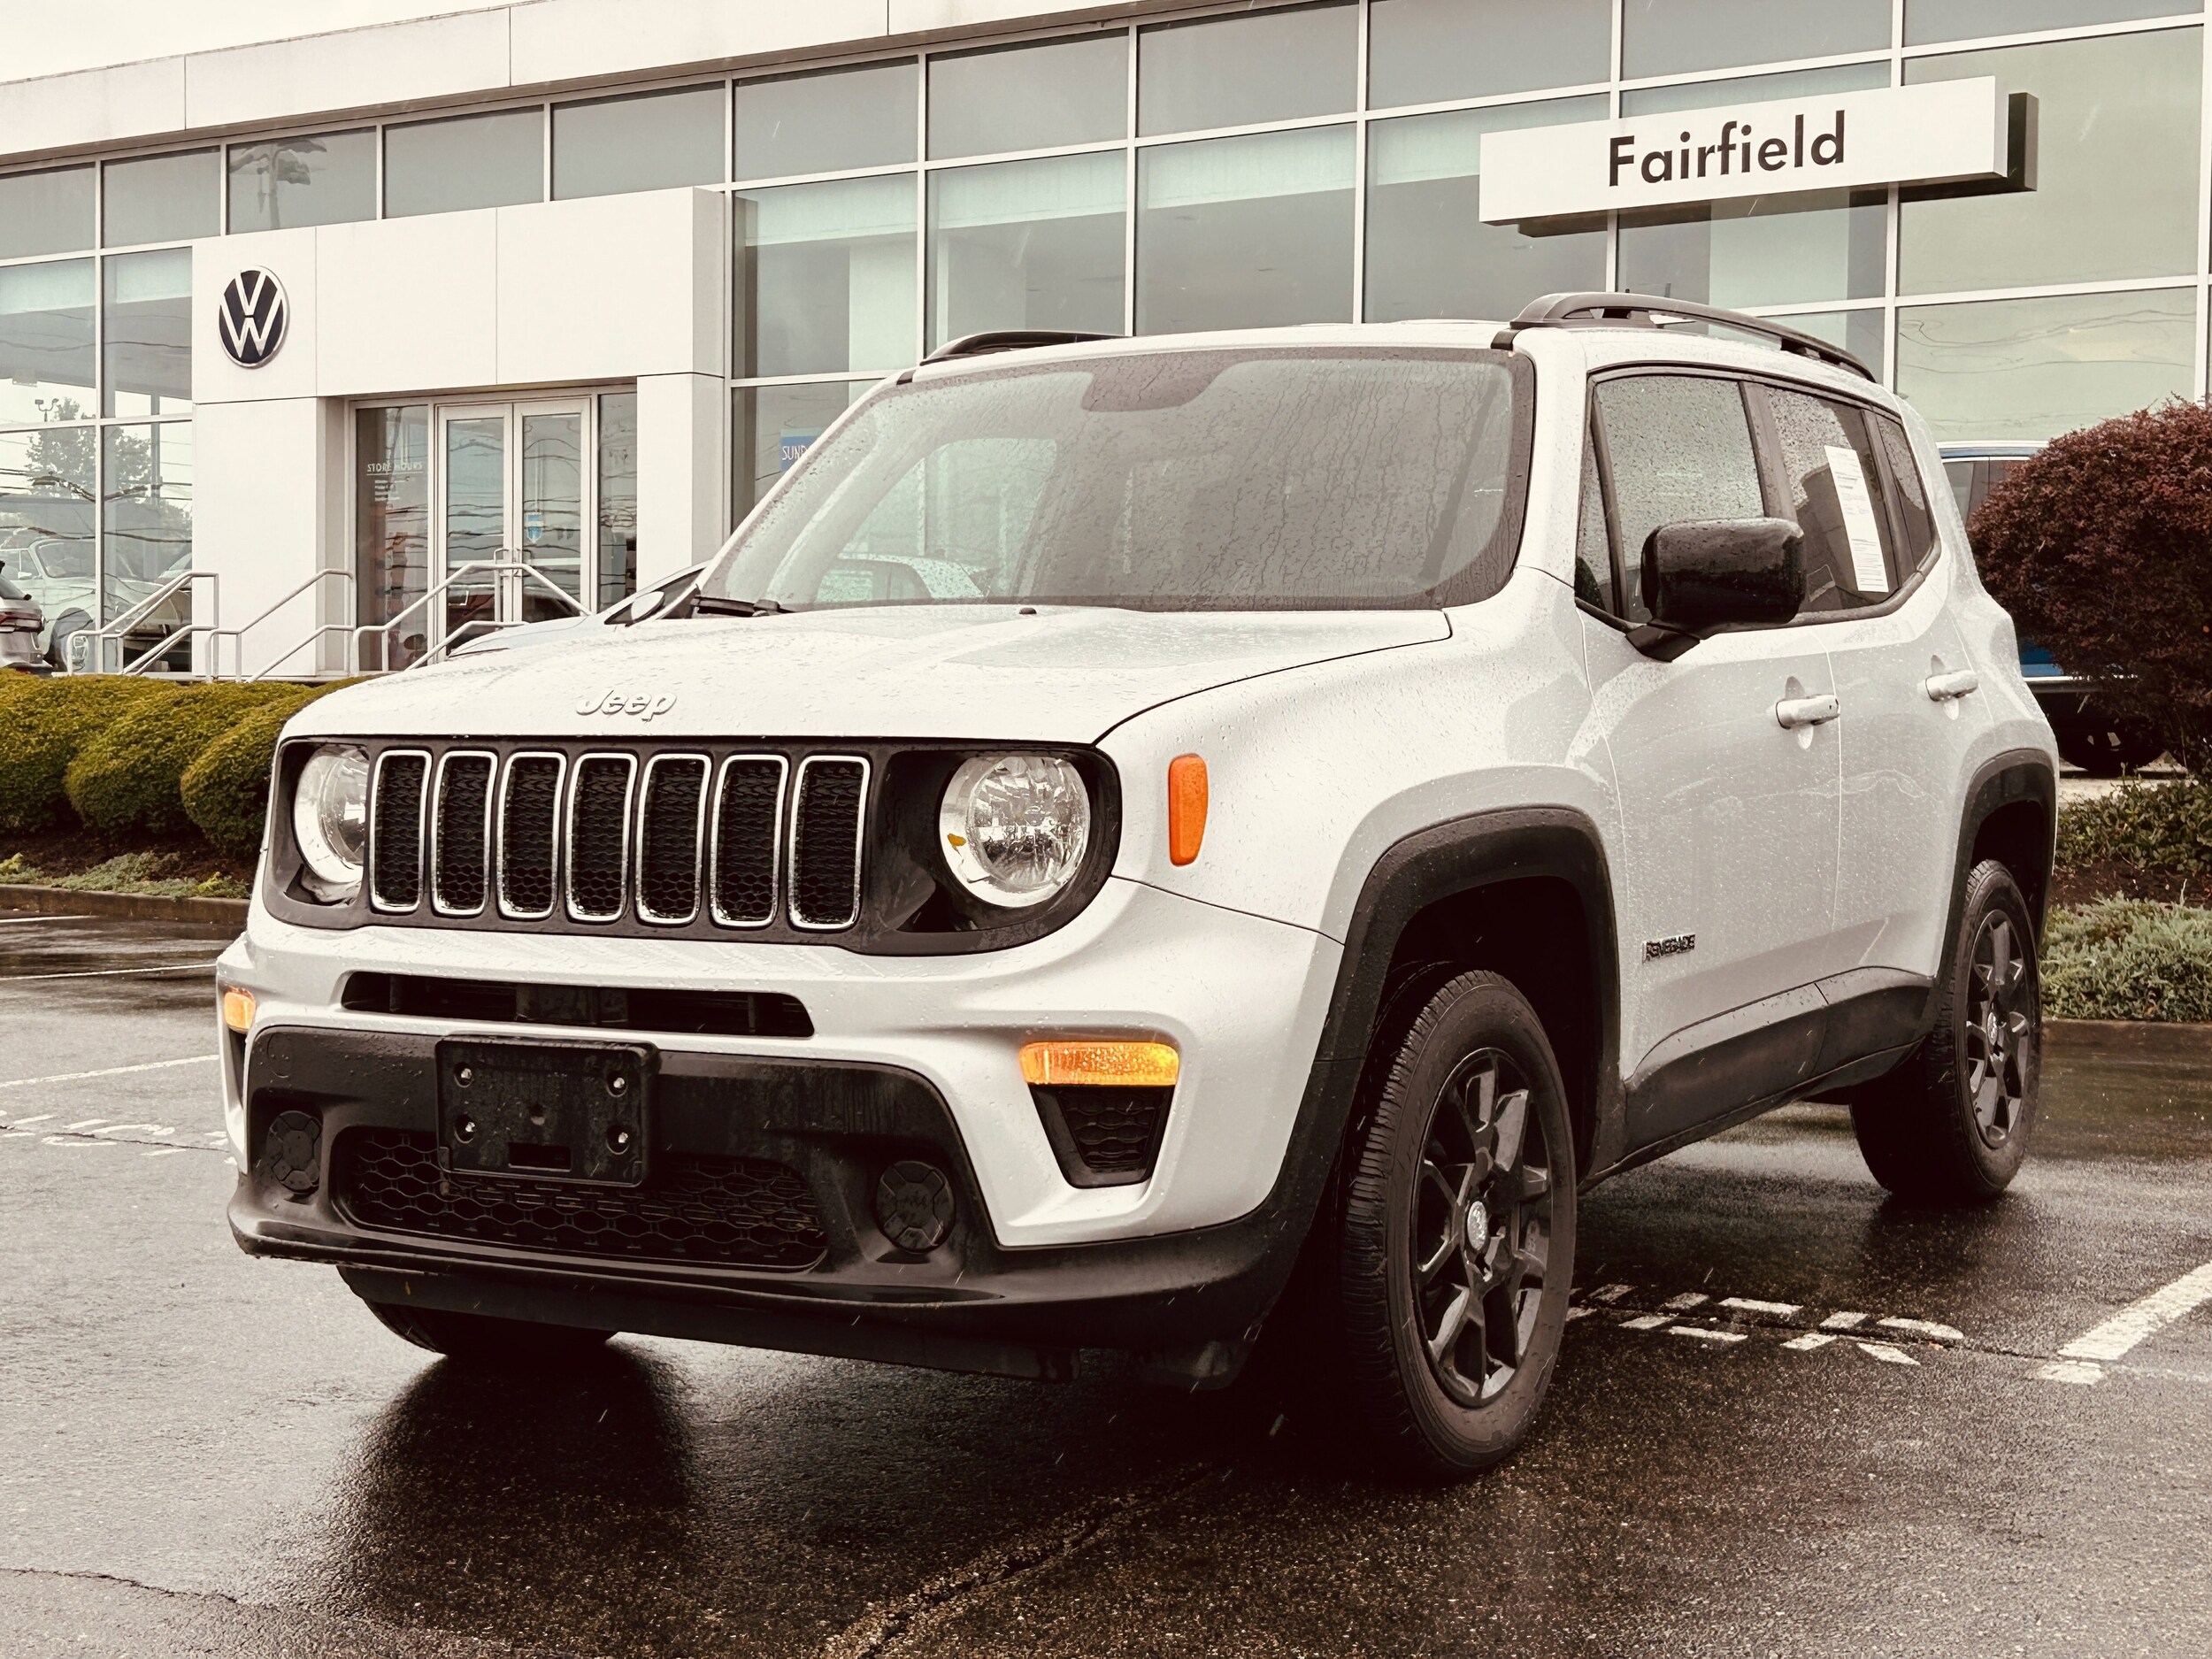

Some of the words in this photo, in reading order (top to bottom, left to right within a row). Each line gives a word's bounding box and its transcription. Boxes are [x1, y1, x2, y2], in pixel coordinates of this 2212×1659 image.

[1609, 109, 1845, 187] Fairfield
[219, 268, 286, 362] VW
[366, 462, 392, 472] STORE
[575, 689, 678, 722] Jeep
